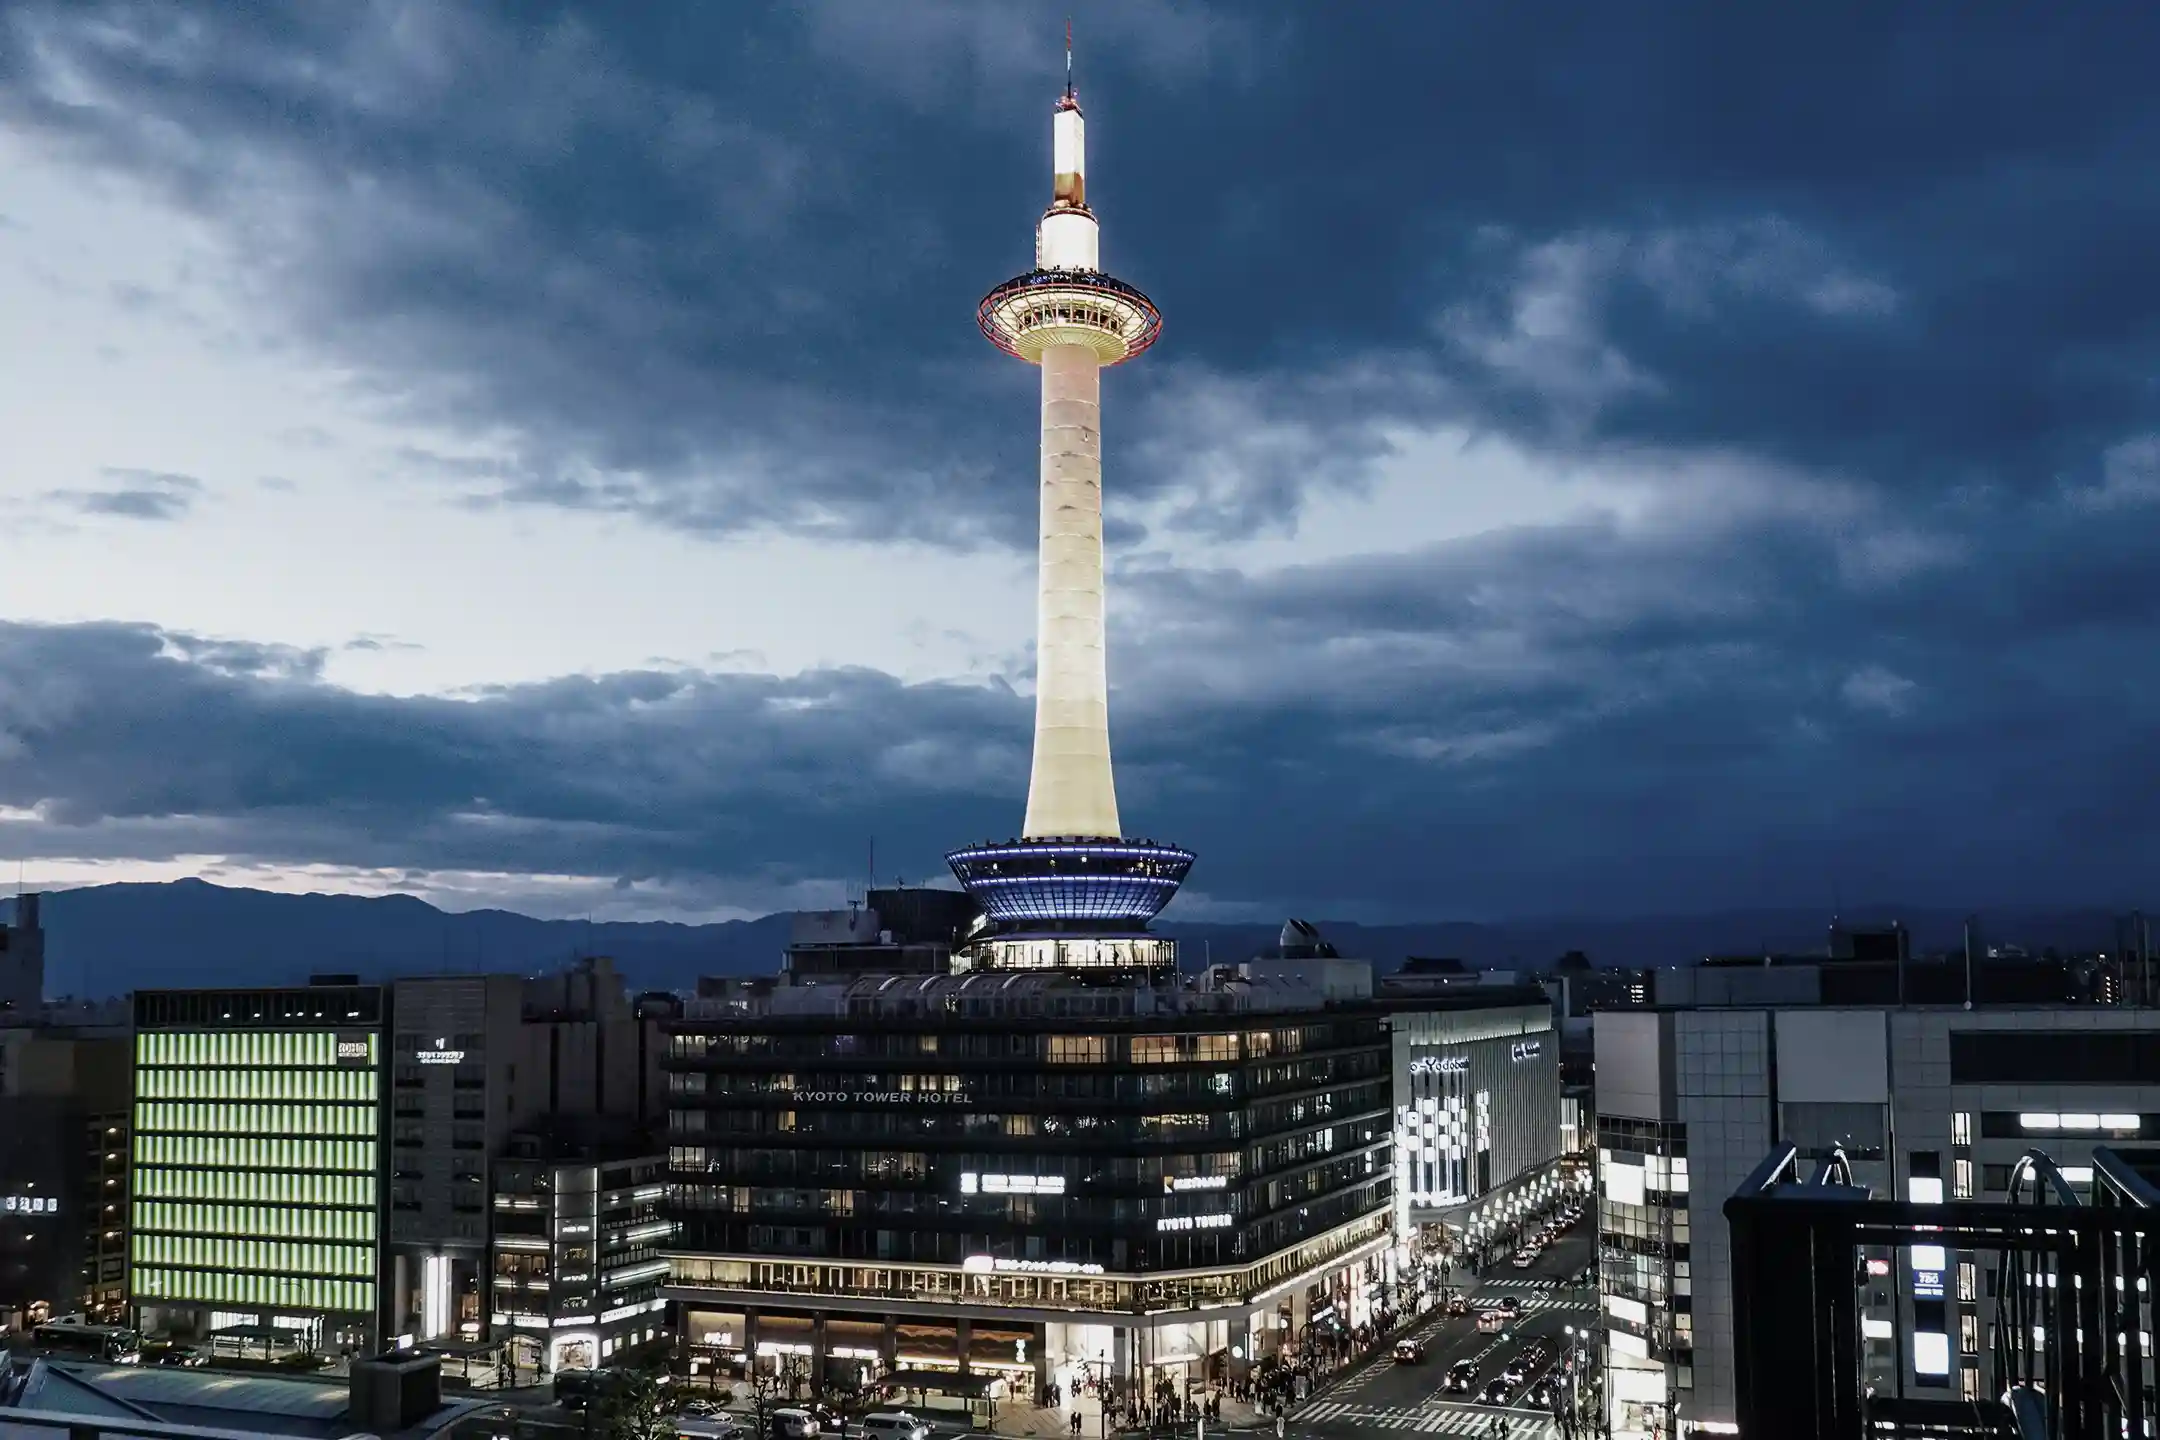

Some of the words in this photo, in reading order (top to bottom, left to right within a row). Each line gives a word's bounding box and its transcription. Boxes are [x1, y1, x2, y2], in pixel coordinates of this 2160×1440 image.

[793, 1092, 848, 1102] KYOTO
[853, 1092, 911, 1103] TOWER
[917, 1092, 973, 1104] HOTEL
[1157, 1218, 1193, 1231] KYOTO
[1195, 1215, 1232, 1228] TOWER
